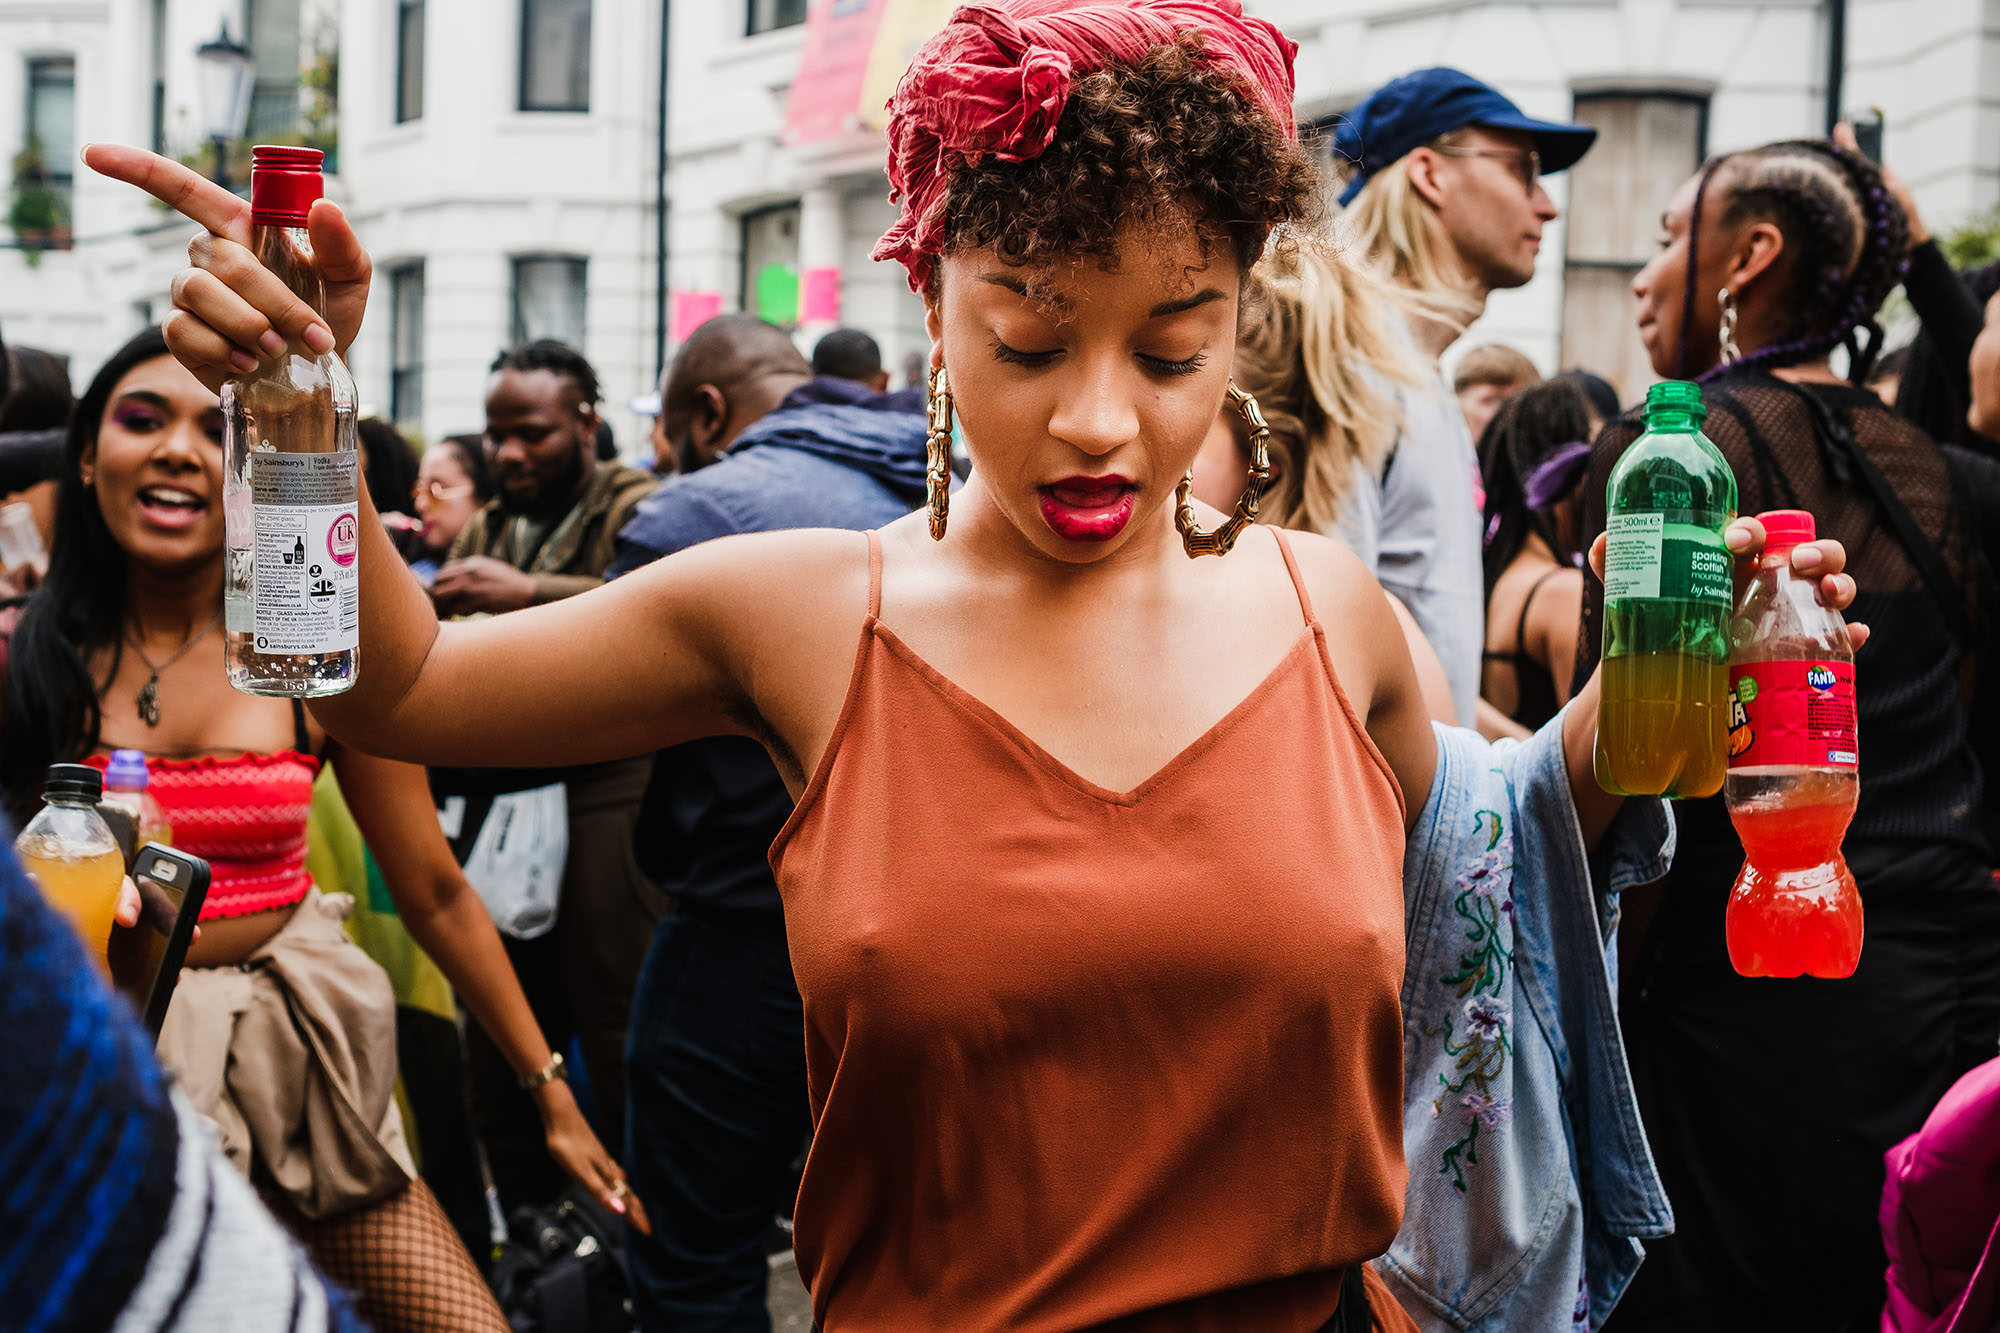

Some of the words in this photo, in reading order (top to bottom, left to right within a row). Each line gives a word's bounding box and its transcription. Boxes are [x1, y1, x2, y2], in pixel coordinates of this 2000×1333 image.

[254, 458, 263, 467] by
[264, 458, 304, 468] Sainsbury's
[314, 457, 330, 465] Vodka
[1624, 517, 1648, 527] 500ml
[337, 525, 354, 541] UK
[1692, 551, 1727, 567] sparkling
[1691, 560, 1724, 574] Scottish
[1690, 583, 1703, 597] by
[1807, 671, 1836, 685] FANTA
